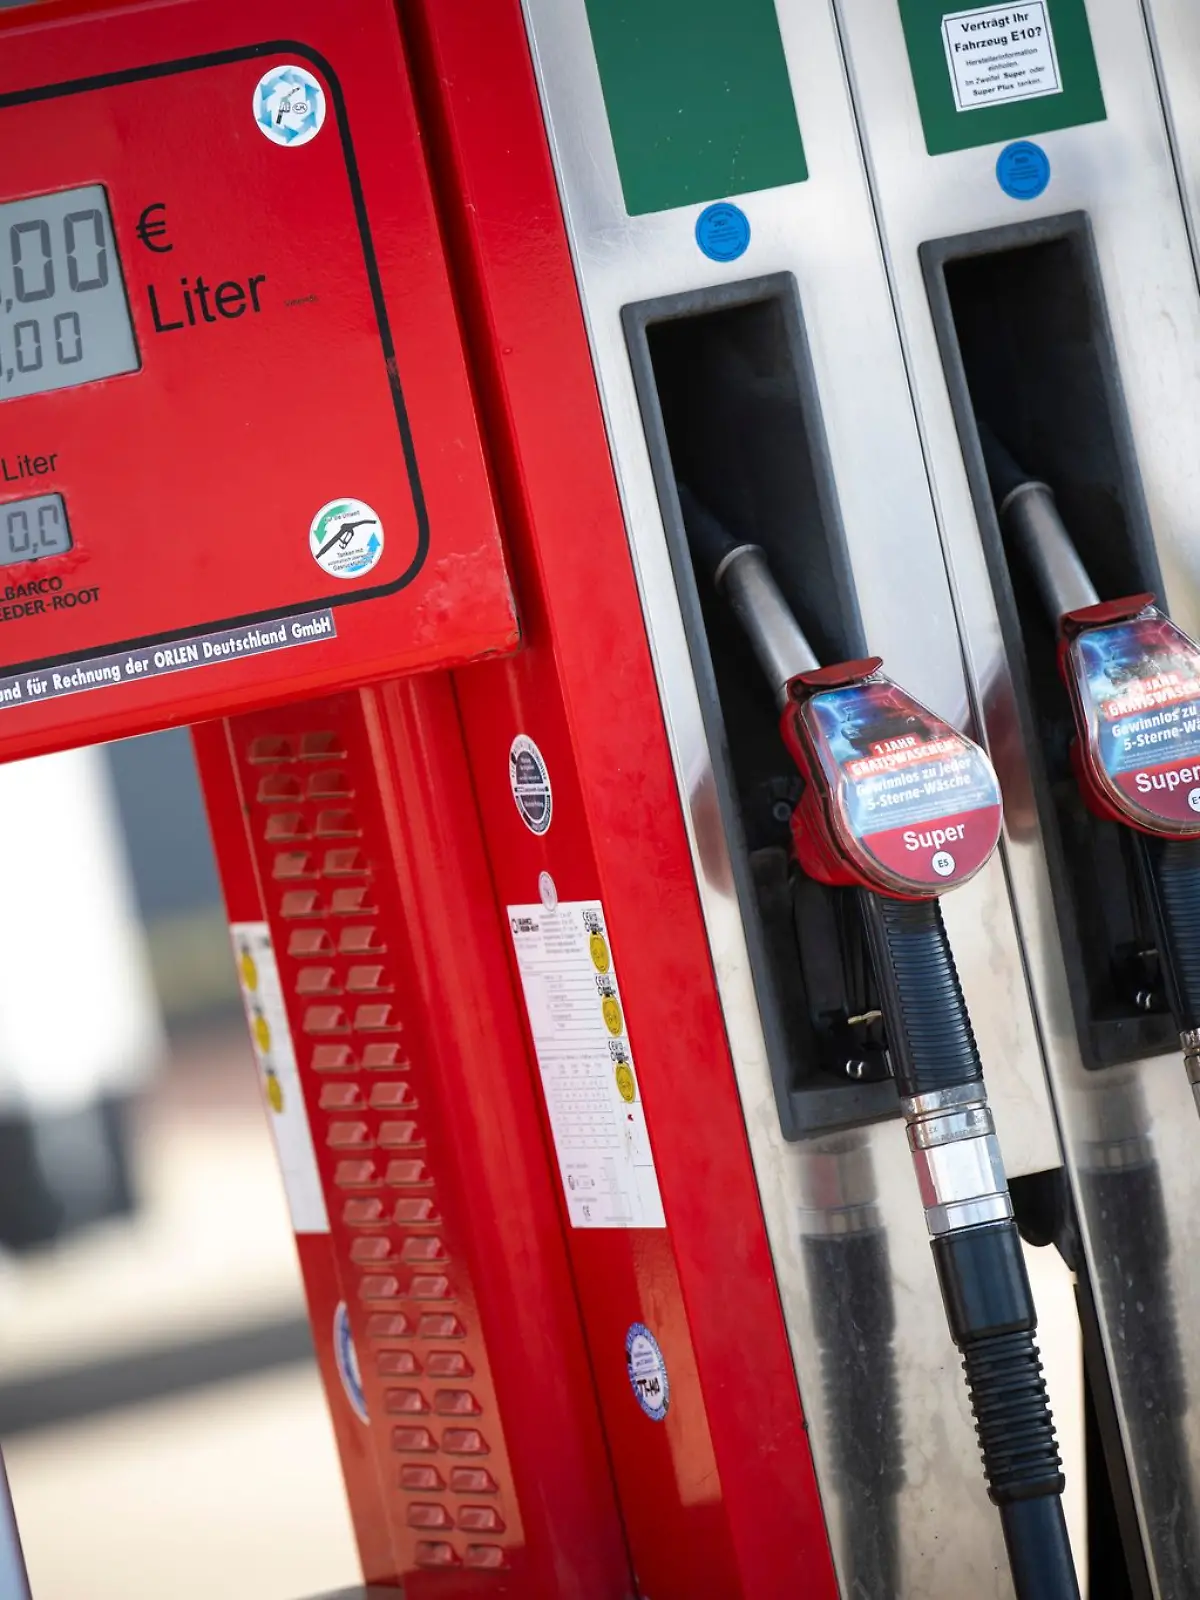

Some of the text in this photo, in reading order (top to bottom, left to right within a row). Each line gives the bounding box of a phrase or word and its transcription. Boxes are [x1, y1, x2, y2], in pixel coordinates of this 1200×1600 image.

[961, 12, 1029, 32] Verträgt Ihr
[954, 26, 1042, 53] Fahrzeug E10?
[1003, 69, 1026, 80] Super
[973, 87, 995, 97] Super
[997, 83, 1015, 92] Plus
[136, 203, 173, 252] €
[0, 208, 109, 314] ,00
[147, 273, 266, 333] Liter
[0, 311, 83, 383] ,00
[1, 453, 58, 481] Liter
[0, 576, 63, 602] BARCO
[27, 677, 47, 696] für
[52, 664, 121, 690] Rechnung
[125, 657, 149, 675] der
[154, 645, 199, 668] ORLEN
[202, 625, 287, 658] Deutschland
[291, 616, 332, 639] GmbH
[1112, 706, 1198, 738] Gewinnlos zu
[884, 736, 917, 752] JAHR
[921, 767, 937, 779] zu
[1135, 765, 1200, 793] Super
[867, 774, 972, 811] 5-Sterne-Wäsche
[1191, 796, 1200, 805] E
[903, 823, 966, 852] Super
[937, 858, 949, 868] E5
